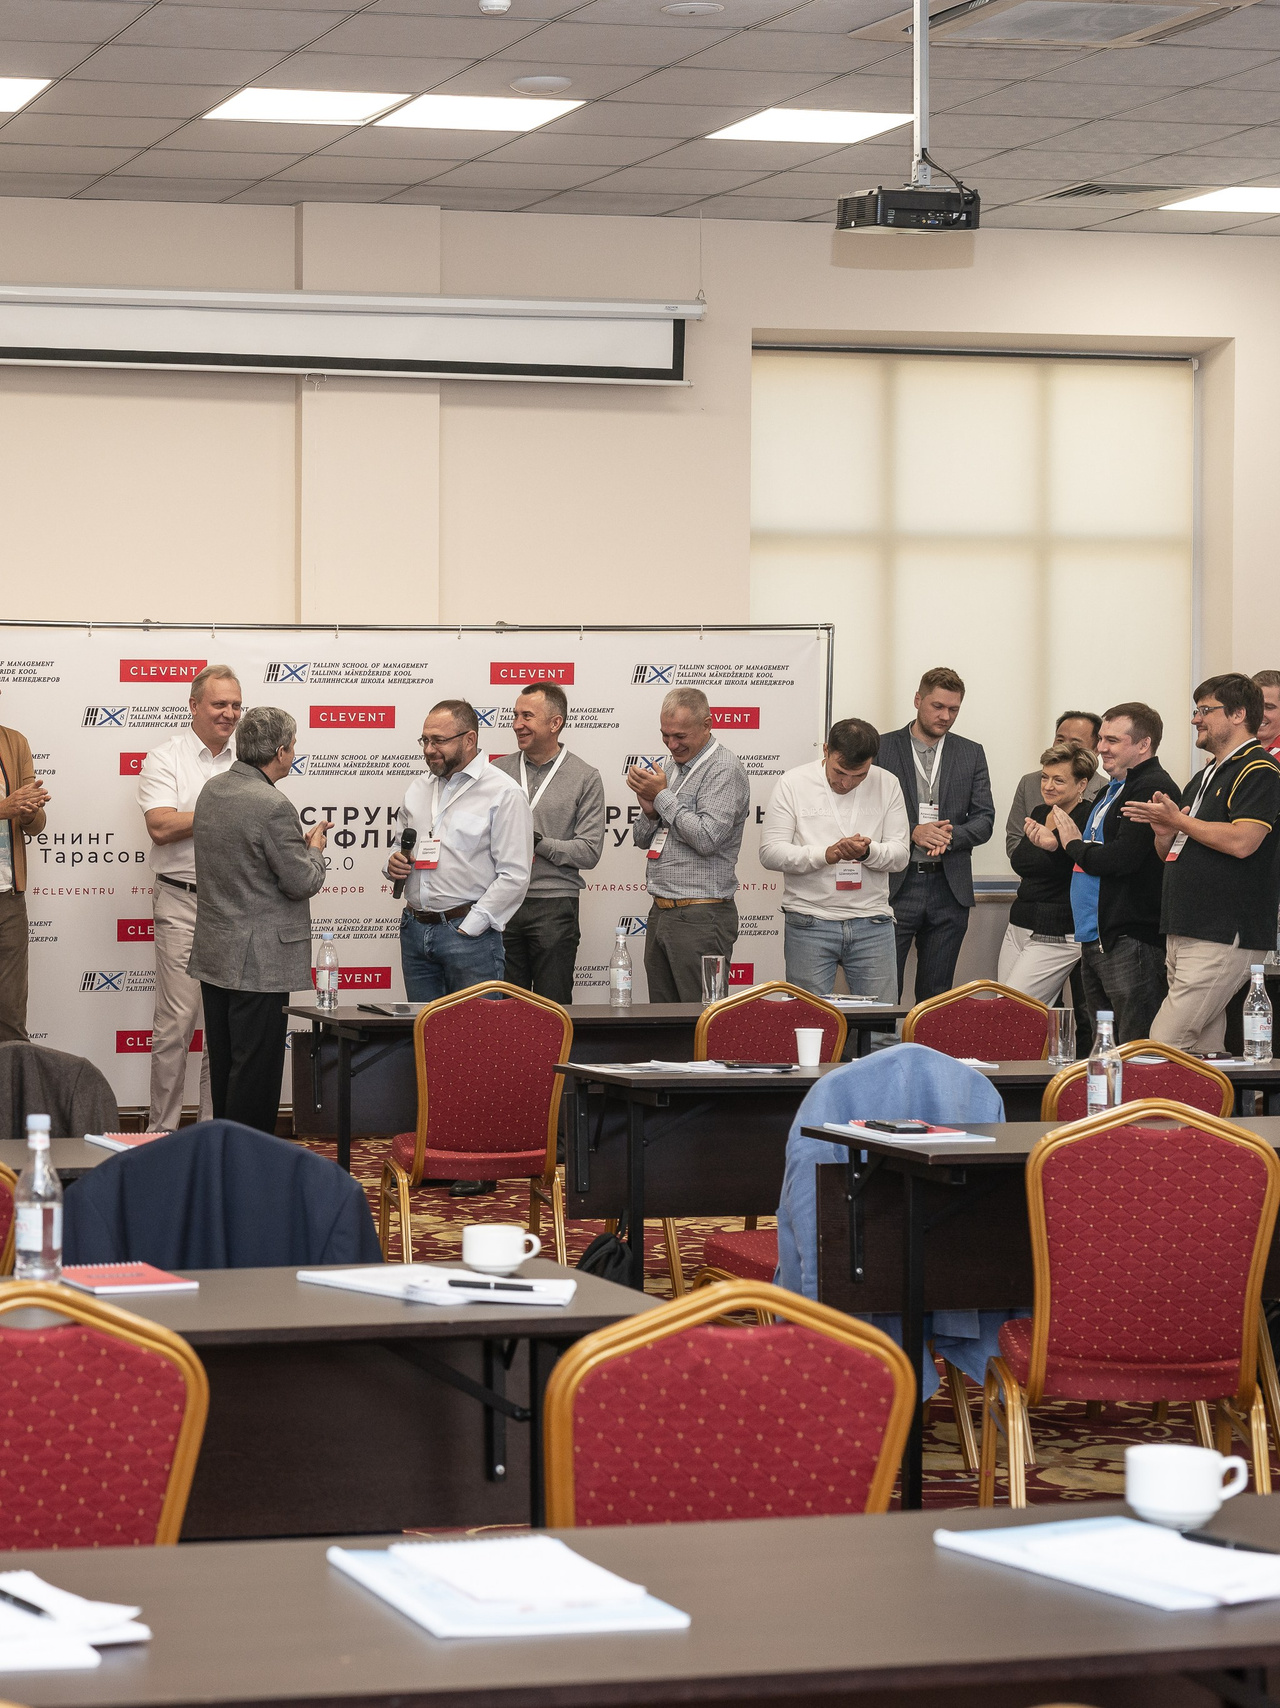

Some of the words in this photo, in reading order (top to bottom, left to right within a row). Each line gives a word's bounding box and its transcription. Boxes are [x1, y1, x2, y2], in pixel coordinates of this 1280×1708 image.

[130, 667, 198, 675] CLEVENT
[500, 669, 564, 678] CLEVENT
[320, 713, 385, 721] CLEVENT
[715, 714, 750, 722] VENT
[336, 974, 381, 982] EVENT
